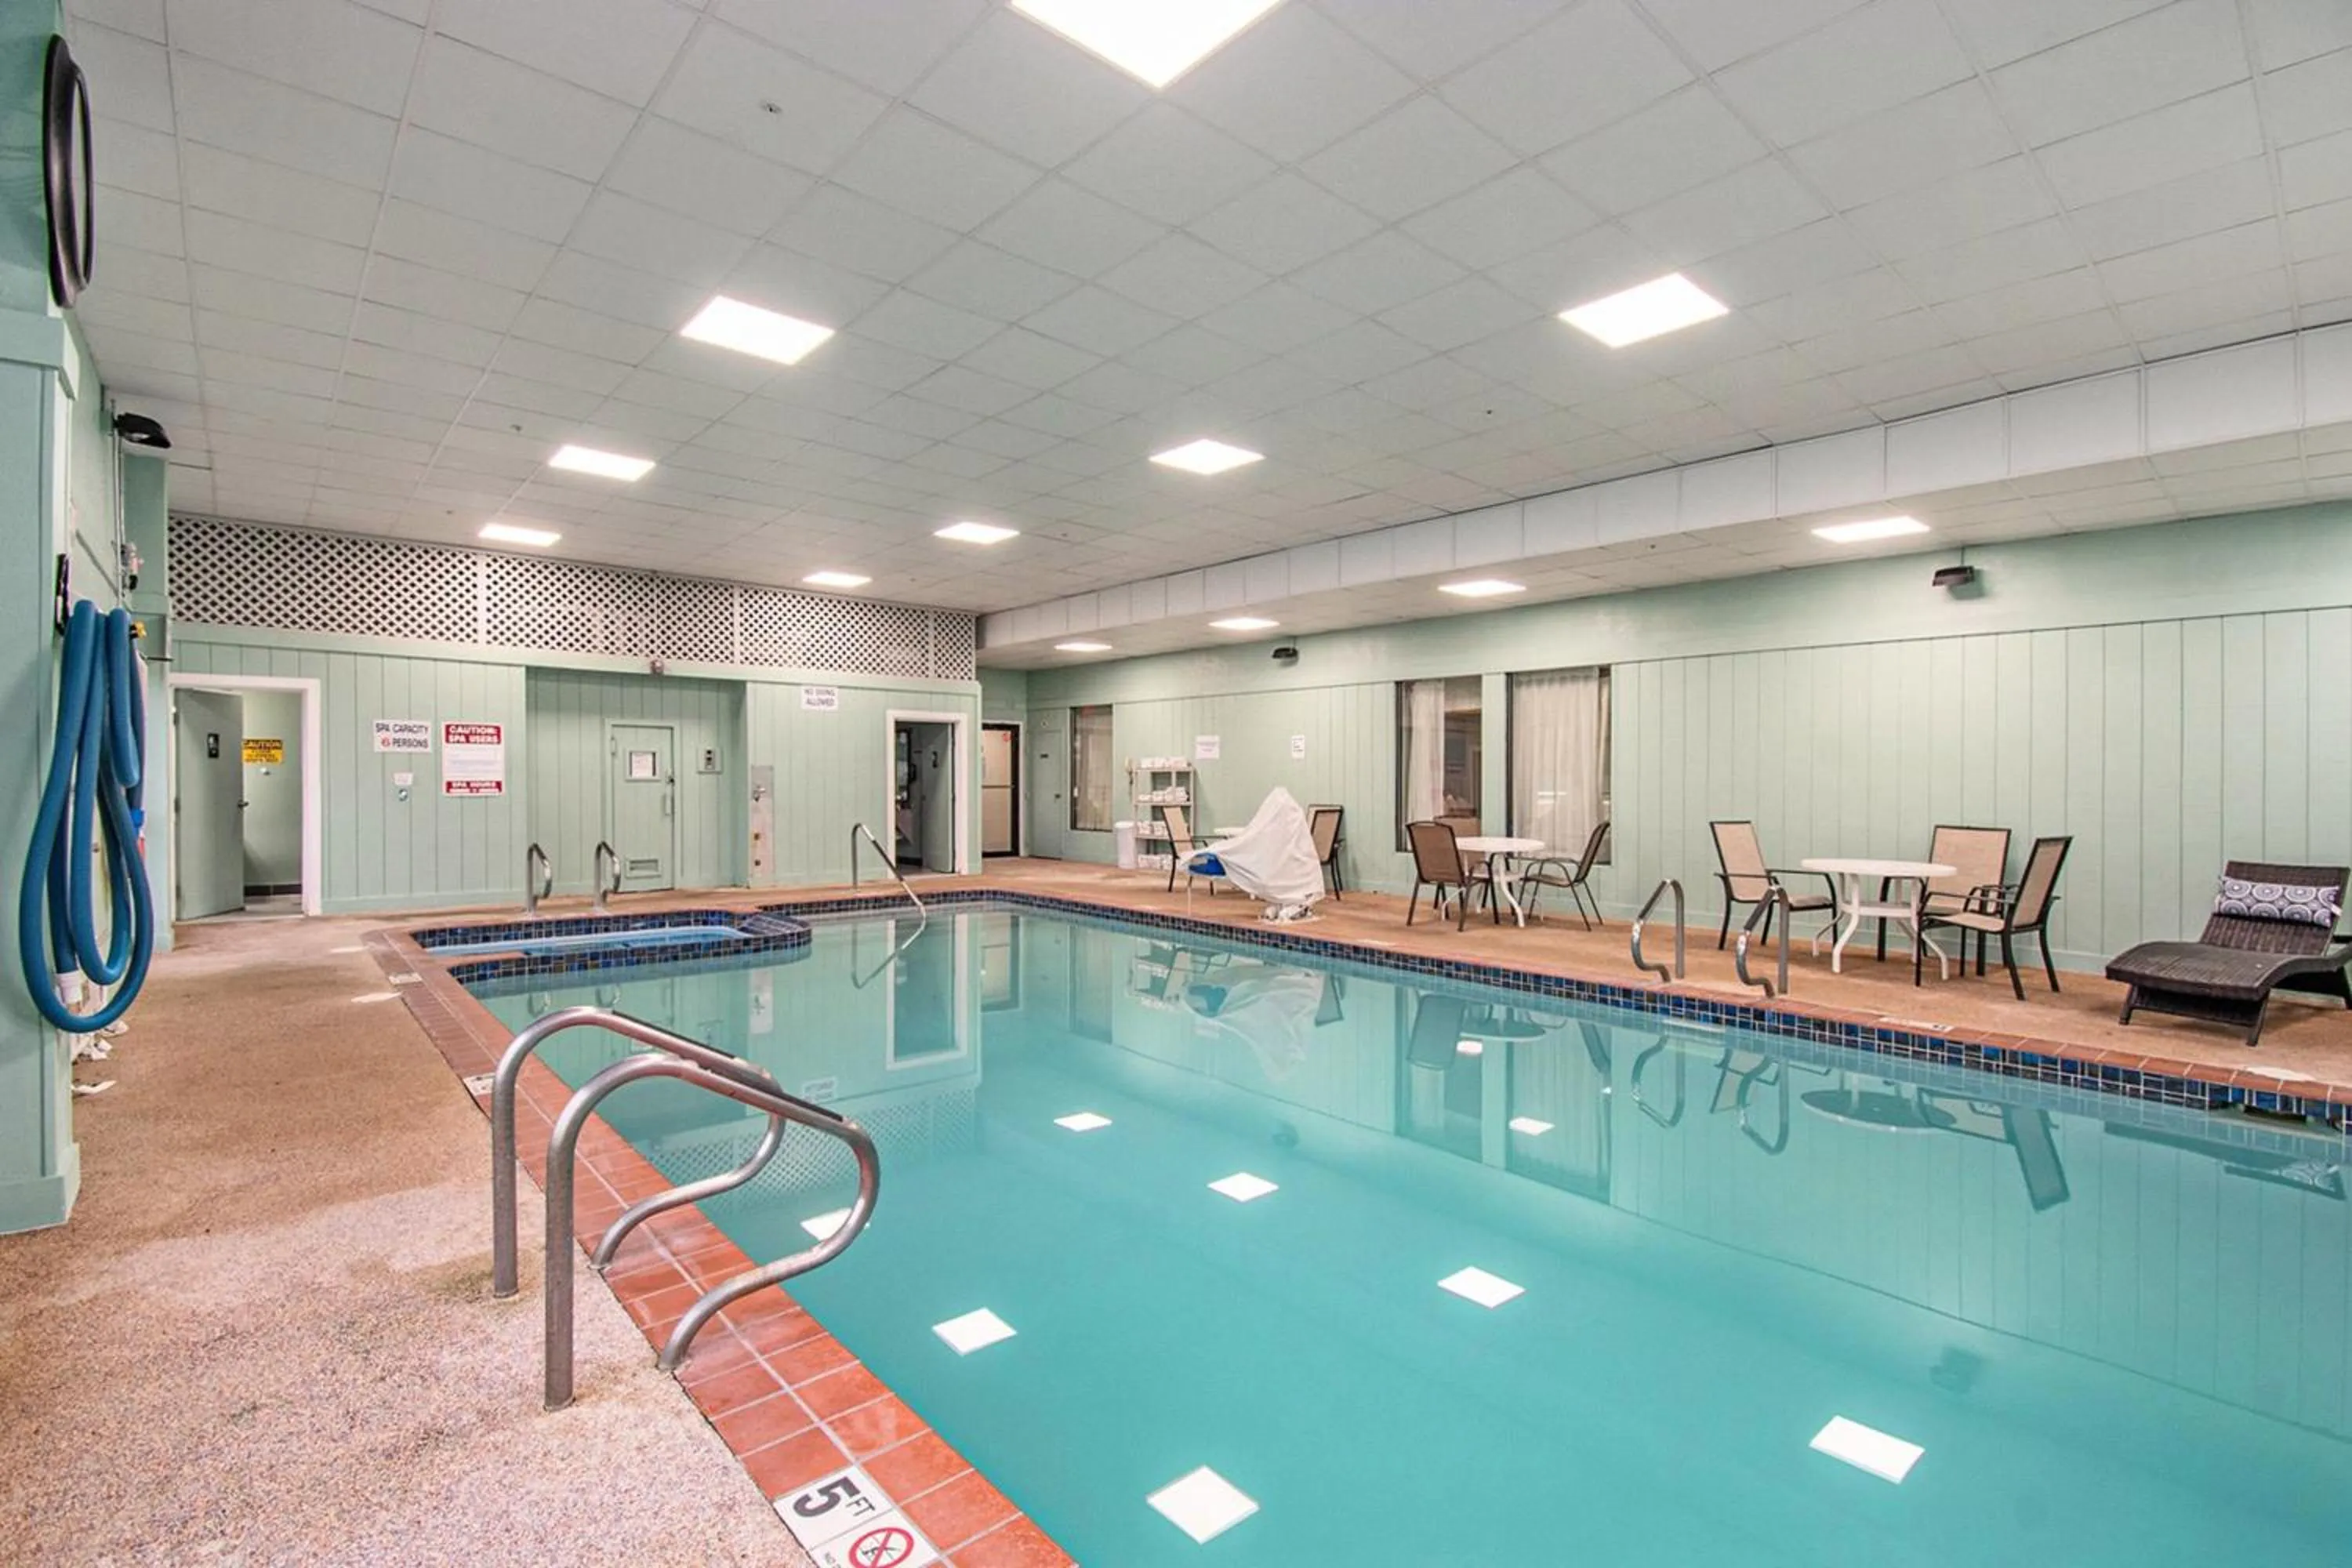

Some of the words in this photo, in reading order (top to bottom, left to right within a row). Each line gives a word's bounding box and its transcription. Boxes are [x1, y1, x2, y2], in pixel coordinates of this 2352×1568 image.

[805, 698, 835, 706] ALLOWED
[376, 722, 390, 732] SPA
[392, 724, 429, 734] CAPACITY
[392, 738, 429, 749] PERSONS
[448, 735, 466, 743] SPA
[469, 735, 498, 744] USERS
[793, 1476, 861, 1517] 5
[846, 1497, 876, 1517] FT
